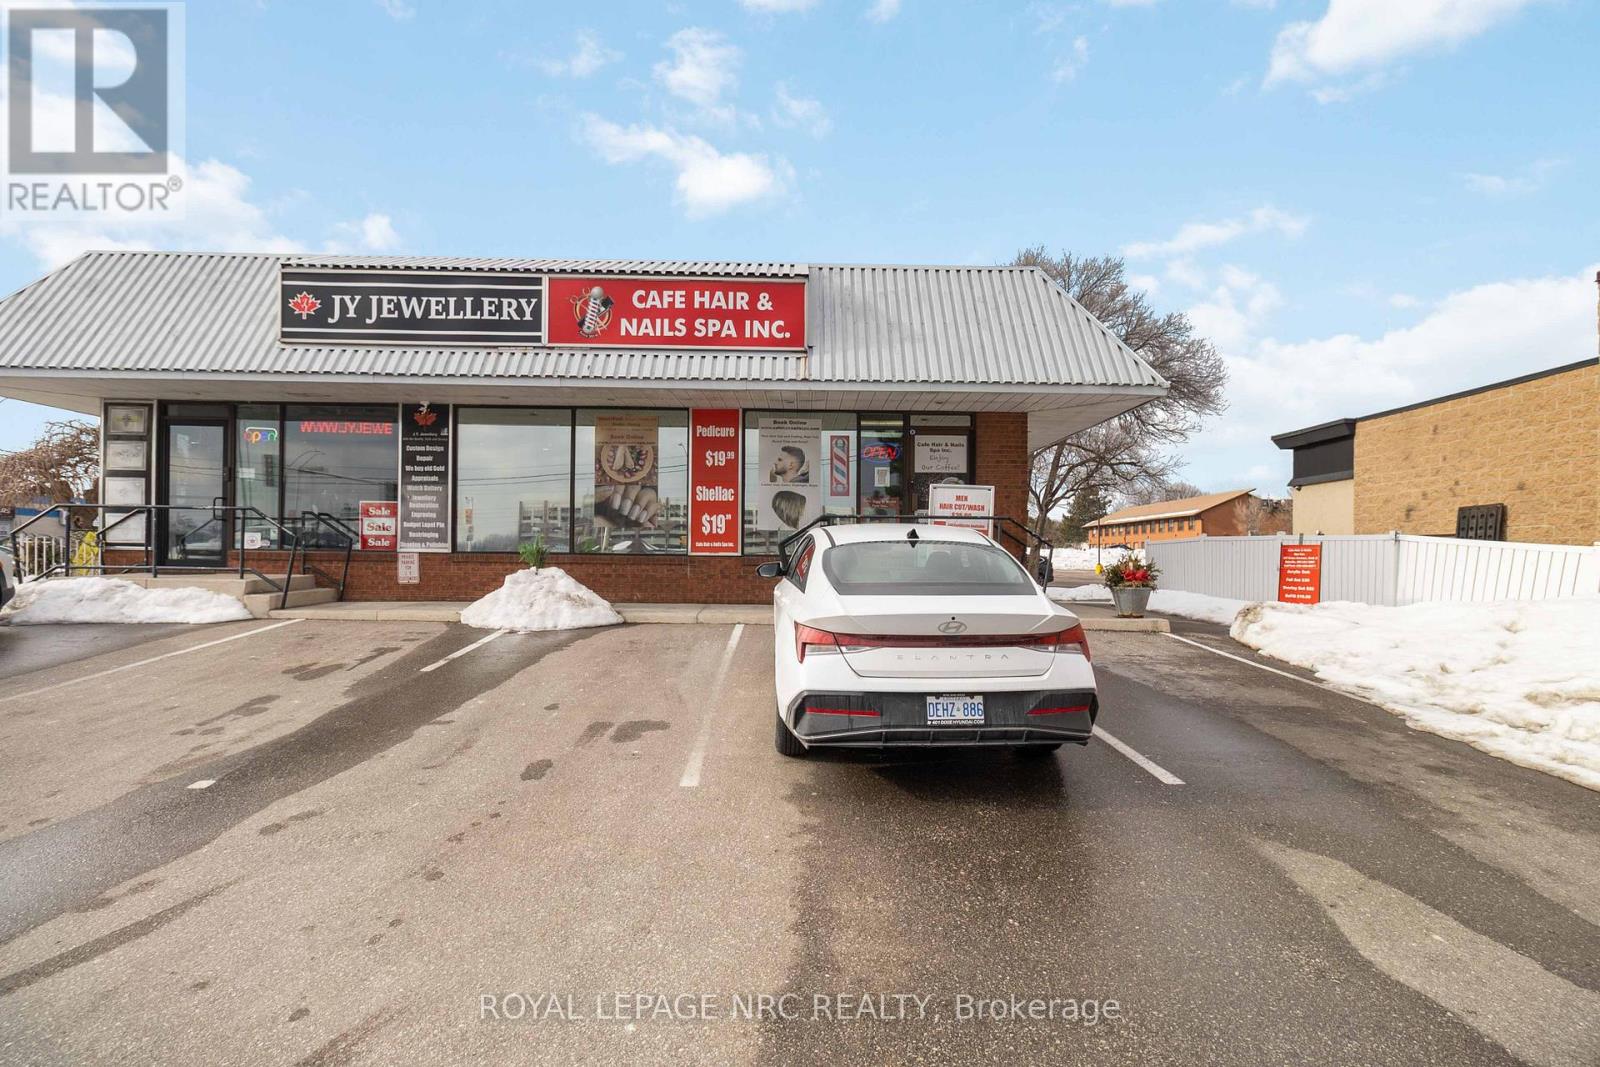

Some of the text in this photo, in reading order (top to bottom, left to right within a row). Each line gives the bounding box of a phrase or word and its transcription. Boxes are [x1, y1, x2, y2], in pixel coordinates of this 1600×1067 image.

[632, 290, 774, 311] CAFE HAIR &
[328, 295, 538, 324] JY JEWELLERY
[620, 318, 687, 337] NAILS
[693, 319, 738, 338] SPA
[745, 320, 791, 339] INC.
[696, 425, 735, 437] Pedicure
[863, 446, 897, 461] OPEN
[695, 485, 735, 501] Shellac
[368, 506, 391, 516] Sale
[954, 503, 985, 511] CUT/WASH
[367, 522, 392, 532] Sale
[367, 537, 391, 547] Sale
[928, 702, 984, 718] DEHZ 886
